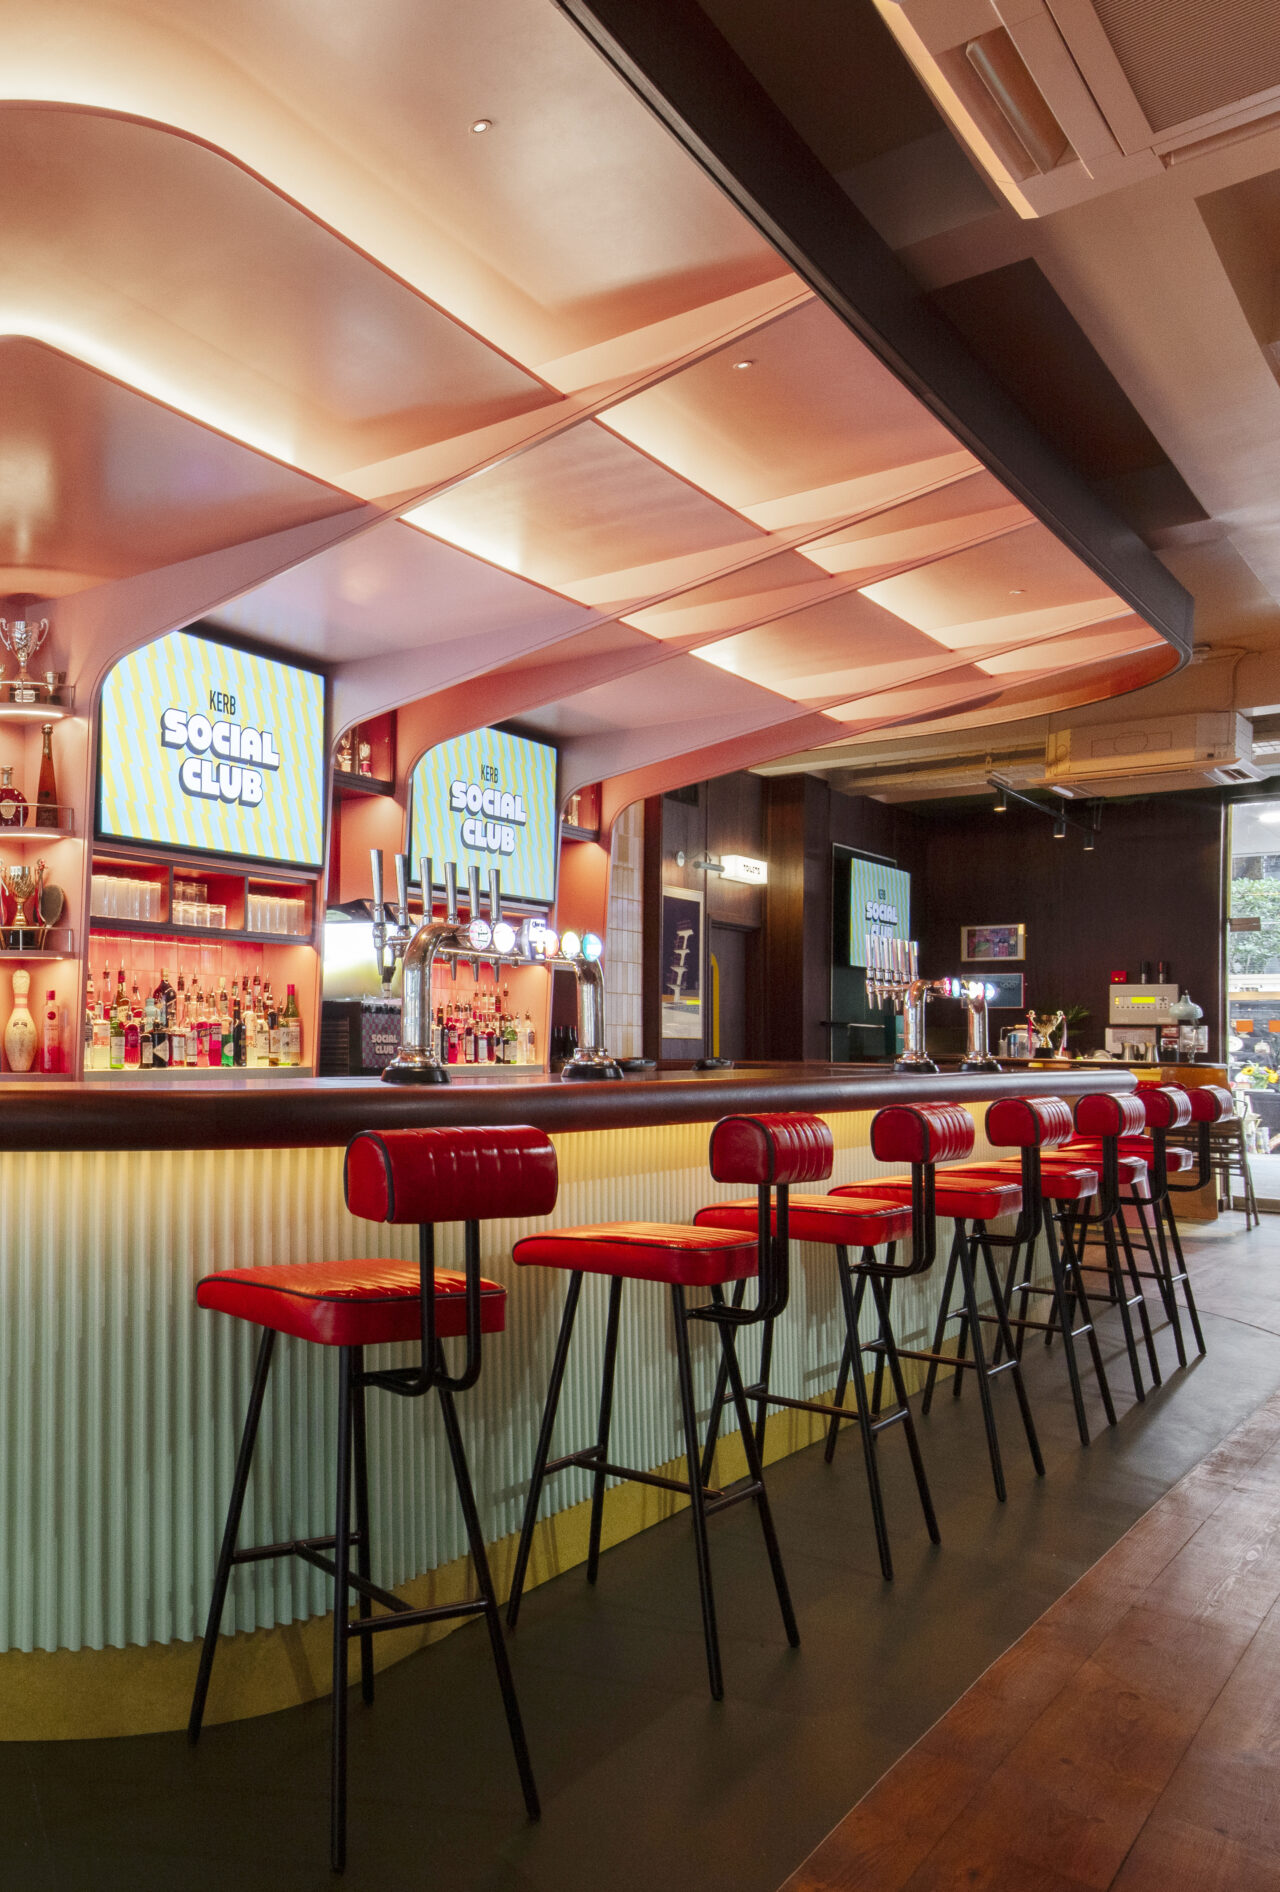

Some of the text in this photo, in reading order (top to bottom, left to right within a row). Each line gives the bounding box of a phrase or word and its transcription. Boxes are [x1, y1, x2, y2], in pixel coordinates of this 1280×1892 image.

[209, 690, 236, 715] KERB
[160, 708, 280, 771] SOCIAL
[178, 757, 263, 808] CLUB
[481, 764, 498, 783] KERB
[449, 780, 527, 826] SOCIAL
[460, 817, 515, 857] CLUB
[865, 900, 898, 926] SOCIAL
[371, 1034, 398, 1044] SOCIAL
[375, 1045, 394, 1055] CLUB
